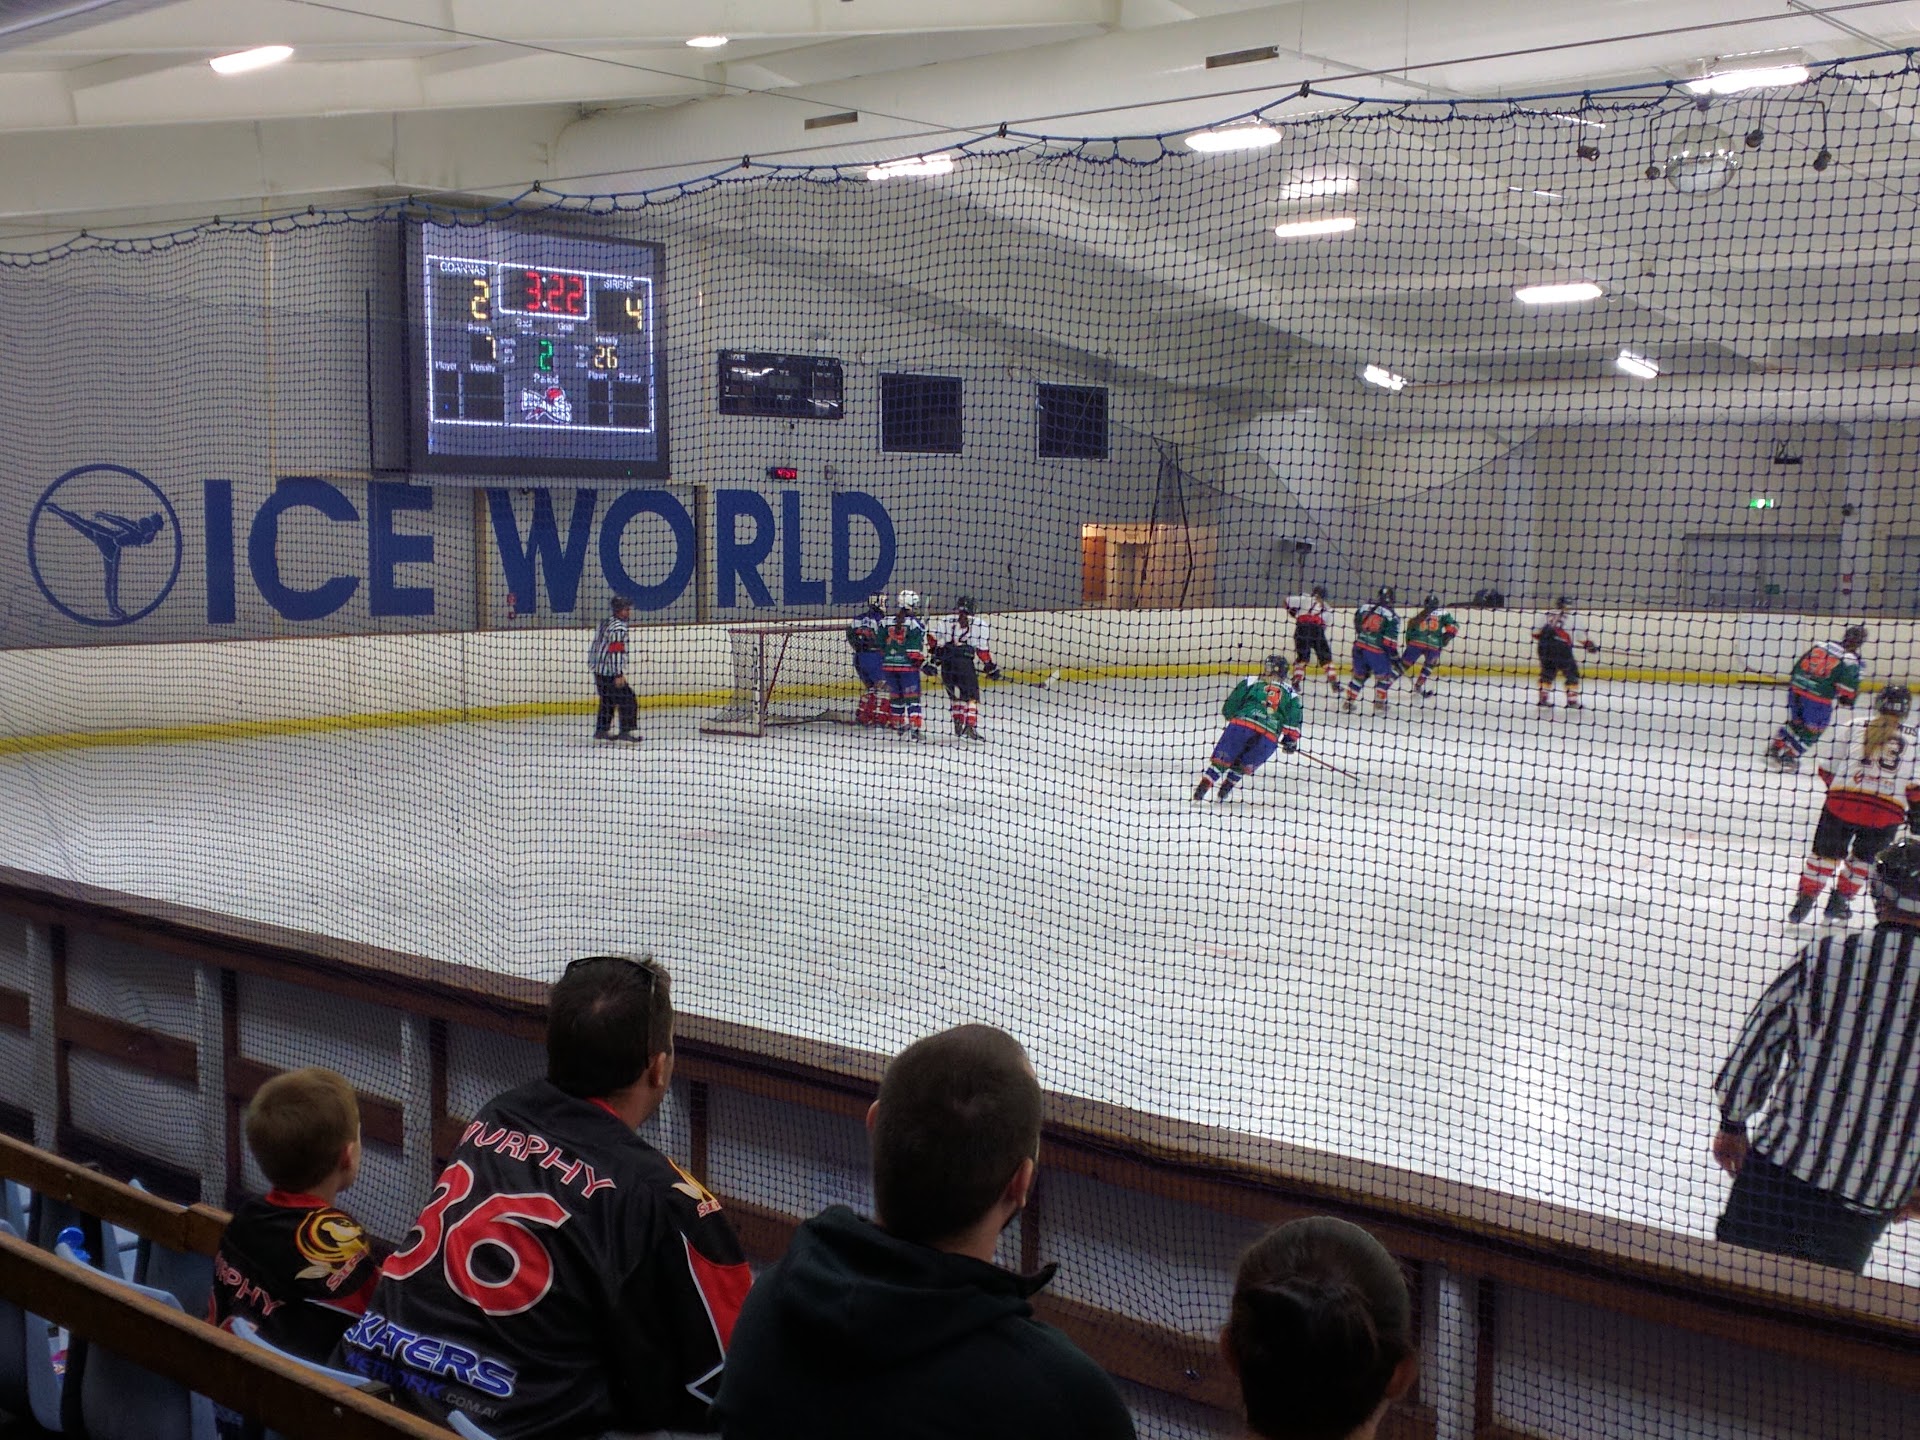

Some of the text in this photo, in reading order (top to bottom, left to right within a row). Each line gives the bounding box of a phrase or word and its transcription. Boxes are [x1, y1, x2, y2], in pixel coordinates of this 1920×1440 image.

[471, 279, 489, 319] 2
[525, 271, 583, 314] 3:22
[603, 279, 634, 291] SIRENS
[625, 296, 643, 330] 4
[485, 336, 497, 360] 7
[539, 340, 554, 370] 2
[594, 346, 618, 370] 26
[204, 476, 896, 624] ICE WORLD
[382, 1159, 571, 1317] 36
